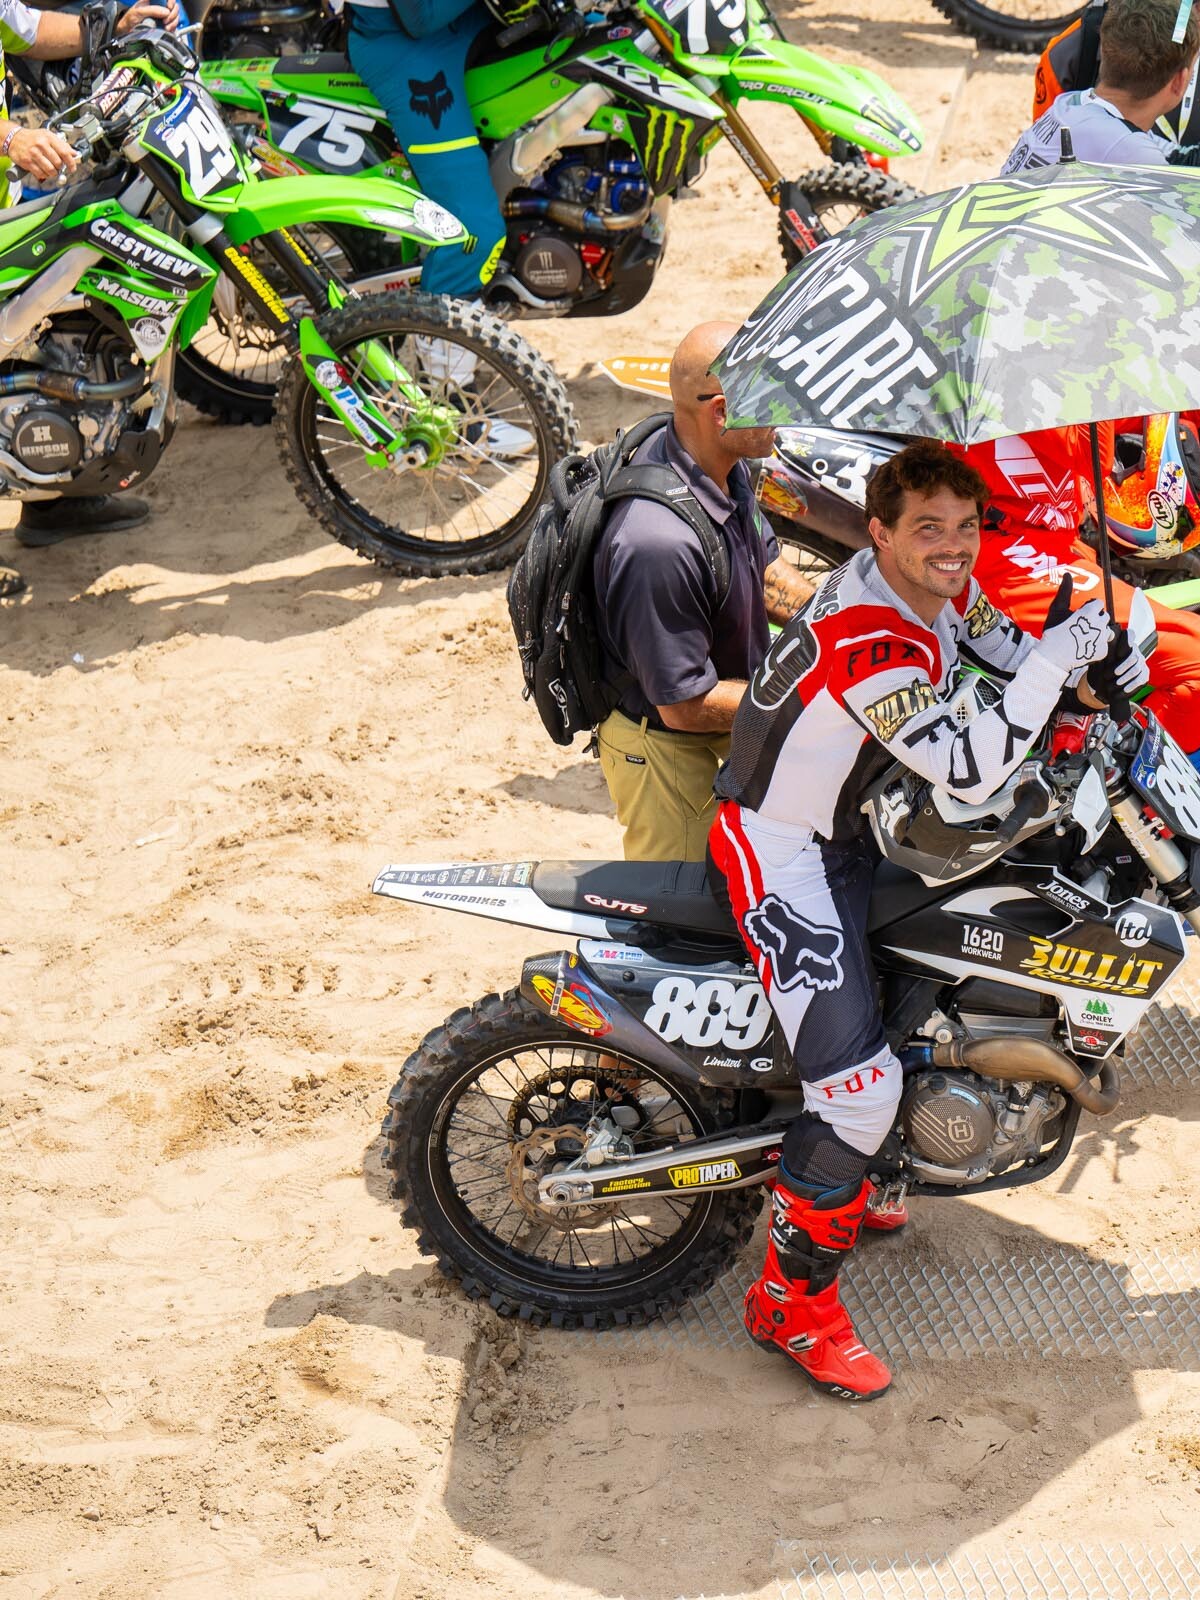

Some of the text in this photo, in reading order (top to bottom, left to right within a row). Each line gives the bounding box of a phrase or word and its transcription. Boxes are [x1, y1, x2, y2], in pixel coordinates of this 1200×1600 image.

[593, 54, 684, 97] KX
[767, 84, 833, 106] CIRCUIT
[279, 100, 377, 167] 75
[90, 217, 199, 279] CRESTVIEW
[126, 258, 142, 271] INC
[97, 276, 176, 315] MASON
[21, 442, 70, 458] HINSON
[847, 640, 925, 678] FOX
[421, 889, 508, 908] MOTORBIKES
[583, 893, 649, 915] GUTS
[1036, 878, 1091, 911] Jones
[1045, 890, 1082, 914] GENERAL STORE
[963, 924, 1005, 952] 1620
[593, 949, 625, 961] AMA
[960, 944, 1003, 962] WORKWEAR
[1020, 935, 1164, 990] BULLIT
[1027, 966, 1149, 996] Racing
[643, 976, 773, 1051] 889
[1080, 1012, 1113, 1023] CONLEY
[703, 1055, 743, 1069] Limited
[673, 1160, 738, 1186] PROTAPER
[831, 1384, 864, 1402] FOX
